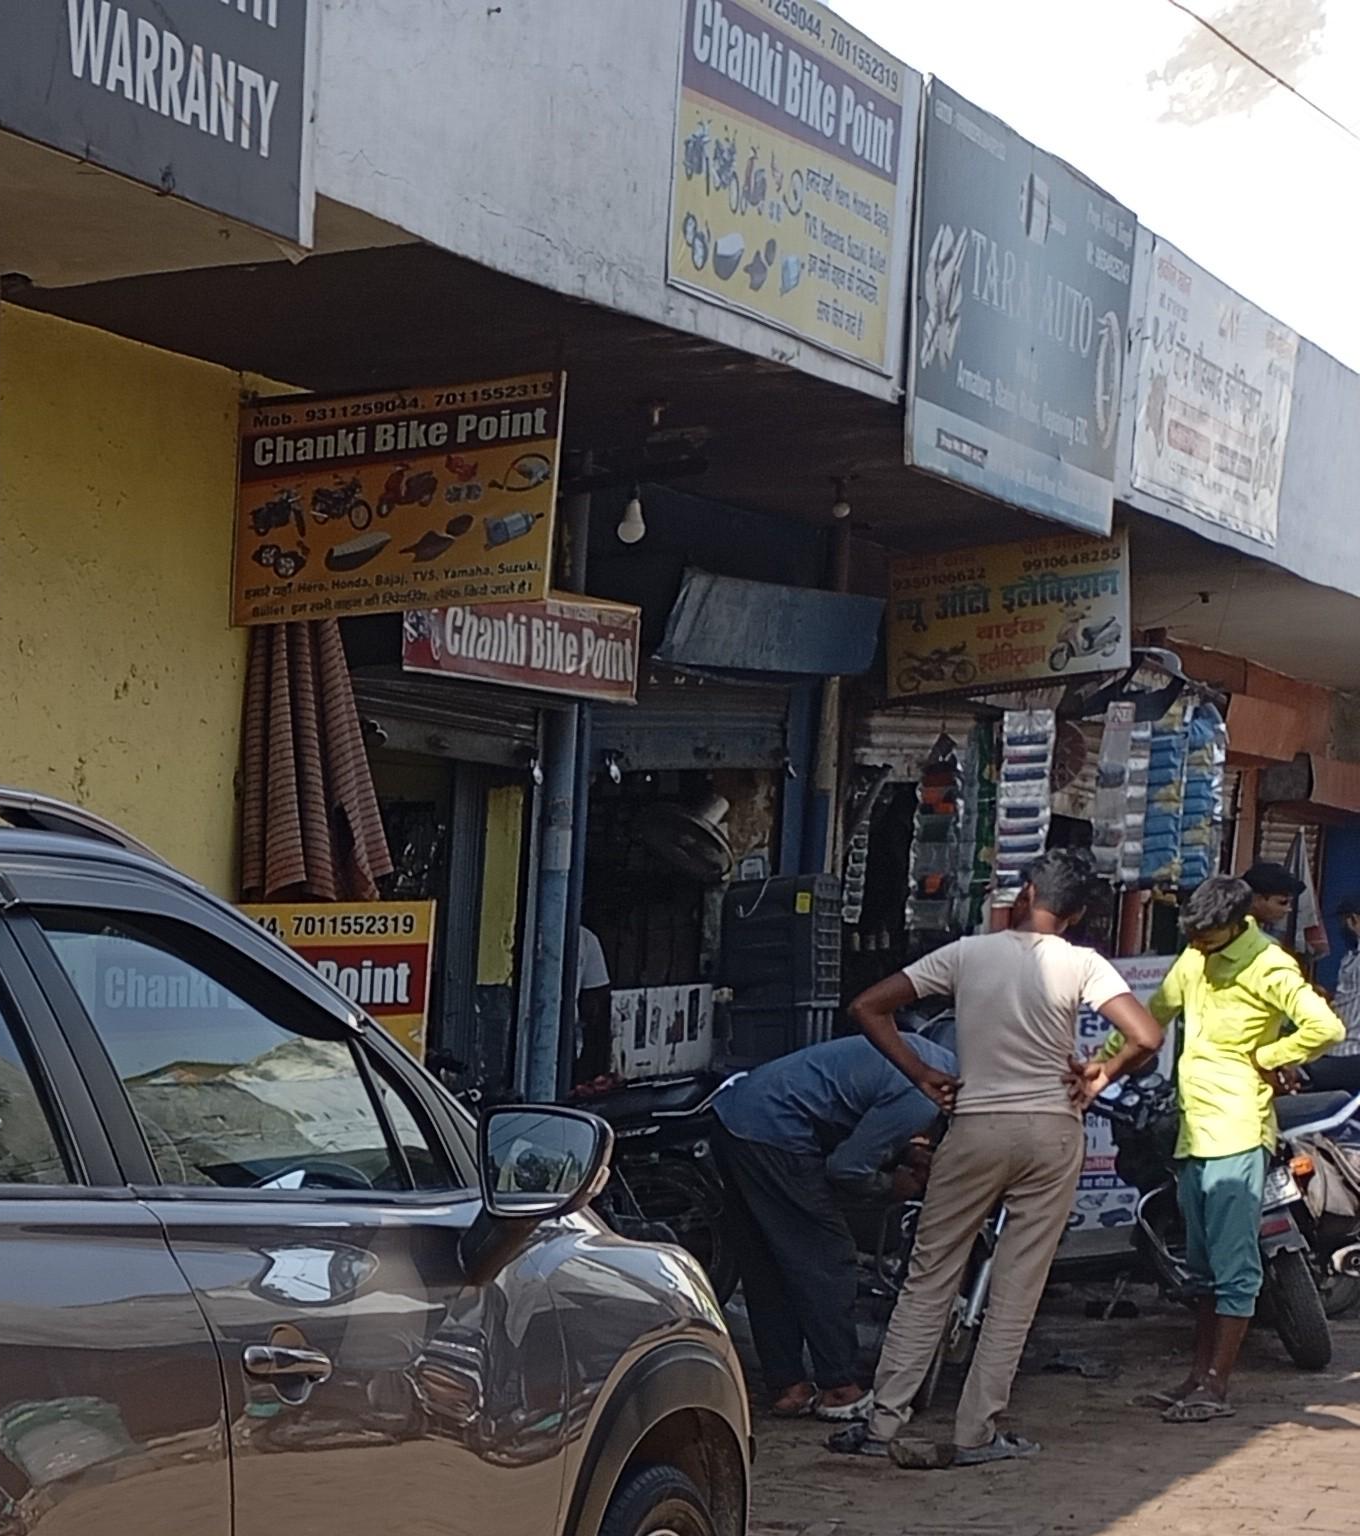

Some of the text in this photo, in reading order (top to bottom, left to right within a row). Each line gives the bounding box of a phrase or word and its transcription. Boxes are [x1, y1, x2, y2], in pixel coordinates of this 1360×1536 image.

[67, 0, 279, 158] WARRANTY
[760, 0, 898, 93] 259044, 7011552319
[693, 0, 783, 106] Chanki
[784, 49, 837, 138] Bike
[838, 84, 895, 173] Point
[970, 229, 1031, 322] TARA
[1041, 274, 1093, 358] AUTO
[253, 414, 296, 428] Mob.
[435, 382, 553, 406] 7011552319
[253, 407, 548, 466] Chanki Bike Point
[332, 577, 371, 589] Honda,
[376, 574, 407, 587] Bajaj,
[413, 569, 438, 581] TVS,
[444, 566, 494, 579] Yamaha,
[498, 562, 541, 574] Suzuki,
[445, 605, 527, 666] Chanki
[531, 618, 578, 674] Bike
[580, 627, 633, 682] Point
[292, 914, 415, 937] 7011552319
[317, 959, 412, 1005] Point
